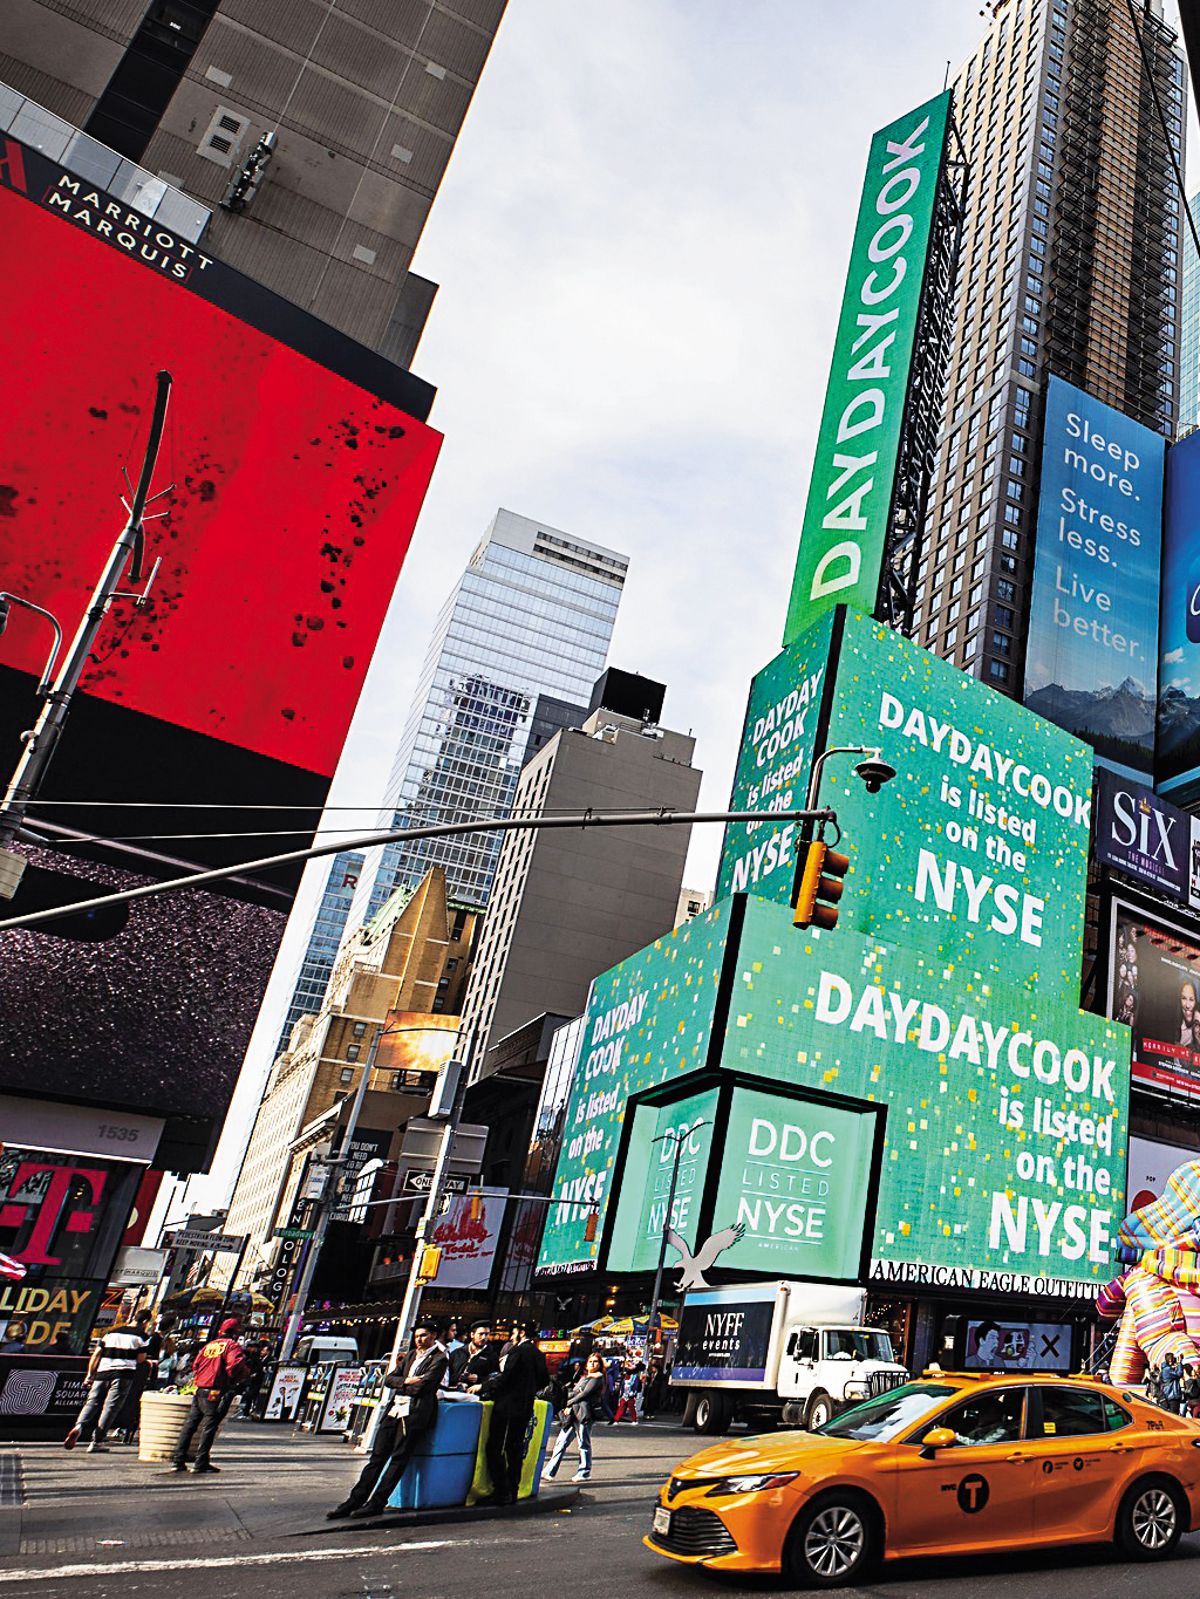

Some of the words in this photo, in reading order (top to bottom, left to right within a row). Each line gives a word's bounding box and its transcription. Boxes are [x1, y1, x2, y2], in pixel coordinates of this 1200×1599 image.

[48, 191, 189, 279] MARQUIS
[58, 174, 214, 271] MARRIOTT
[810, 115, 931, 602] DAYDAYCOOK
[1064, 412, 1141, 471] Sleep
[1063, 447, 1142, 502] more.
[1058, 520, 1119, 568] less.
[1060, 488, 1142, 548] Stress
[1055, 566, 1112, 613] Live
[1053, 598, 1146, 663] better.
[752, 666, 825, 744] DAYDAY
[755, 709, 807, 770] COOK
[877, 691, 1092, 830] DAYDAYCOOK
[747, 784, 760, 808] is
[761, 747, 804, 799] listed
[941, 775, 962, 806] is
[967, 781, 1037, 845] listed
[731, 823, 795, 894] NYSE
[945, 820, 978, 850] on
[985, 826, 1028, 873] the
[914, 848, 1044, 948] NYSE
[590, 990, 650, 1047] DAYDAY
[814, 969, 1117, 1103] DAYDAYCOOK
[584, 1035, 625, 1082] COOK
[574, 1103, 586, 1125] is
[585, 1081, 621, 1121] listed
[997, 1089, 1023, 1129] is
[1031, 1095, 1114, 1151] listed
[97, 1124, 140, 1143] 1535
[568, 1136, 583, 1160] on
[584, 1124, 604, 1152] the
[659, 1116, 706, 1164] DDC
[748, 1118, 836, 1170] DDC
[555, 1170, 607, 1227] NYSE
[742, 1167, 831, 1198] LISTED
[1017, 1150, 1056, 1184] on
[1063, 1151, 1111, 1197] the
[647, 1195, 693, 1234] NYSE
[736, 1200, 824, 1240] NYSE
[987, 1191, 1113, 1266] NYSE
[869, 1259, 975, 1288] AMERICAN
[978, 1270, 1030, 1293] EAGLE
[1033, 1277, 1104, 1300] OUTFITT
[702, 1339, 741, 1350] events
[704, 1312, 745, 1338] NYFF
[964, 1481, 983, 1508] T
